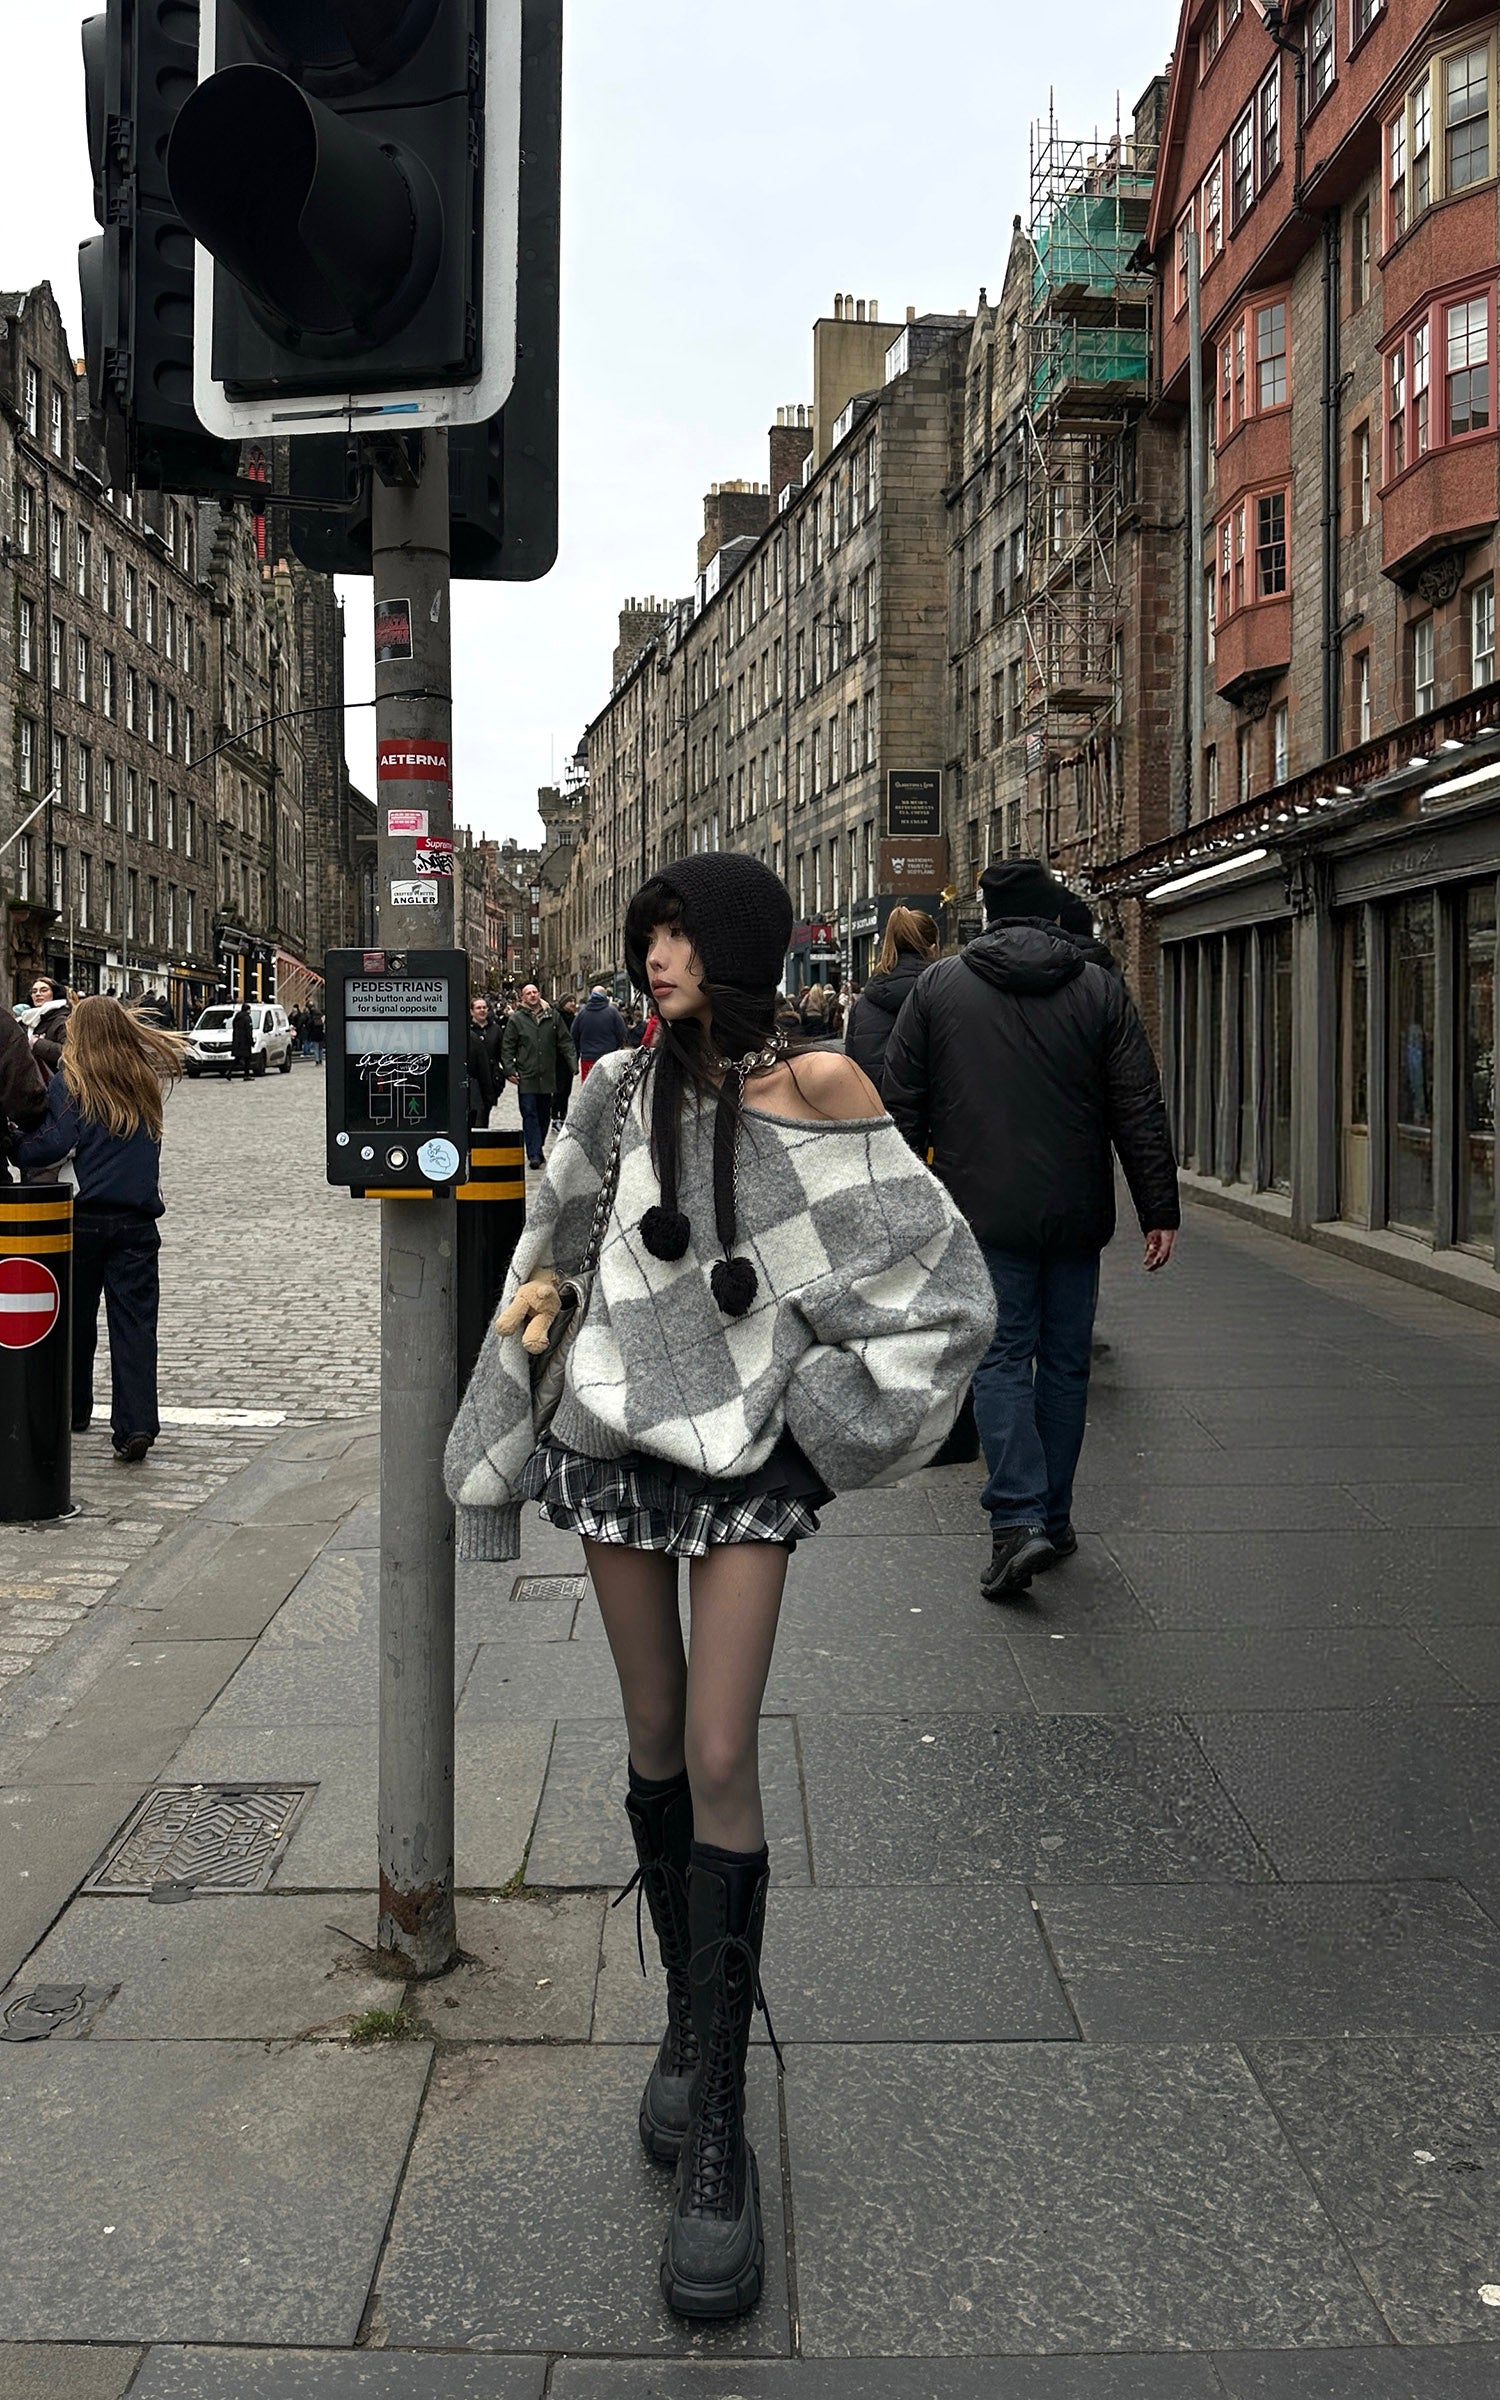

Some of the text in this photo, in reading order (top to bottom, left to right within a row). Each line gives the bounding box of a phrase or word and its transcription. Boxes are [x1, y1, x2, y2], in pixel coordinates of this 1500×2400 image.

[380, 754, 447, 767] AETERNA
[425, 838, 452, 850] Suprem
[352, 981, 443, 992] PEDESTRIANS
[352, 994, 443, 1004] push button and wait
[357, 1004, 438, 1014] for signal opposite
[353, 1023, 440, 1052] WAIT
[221, 1817, 263, 1857] FIRE
